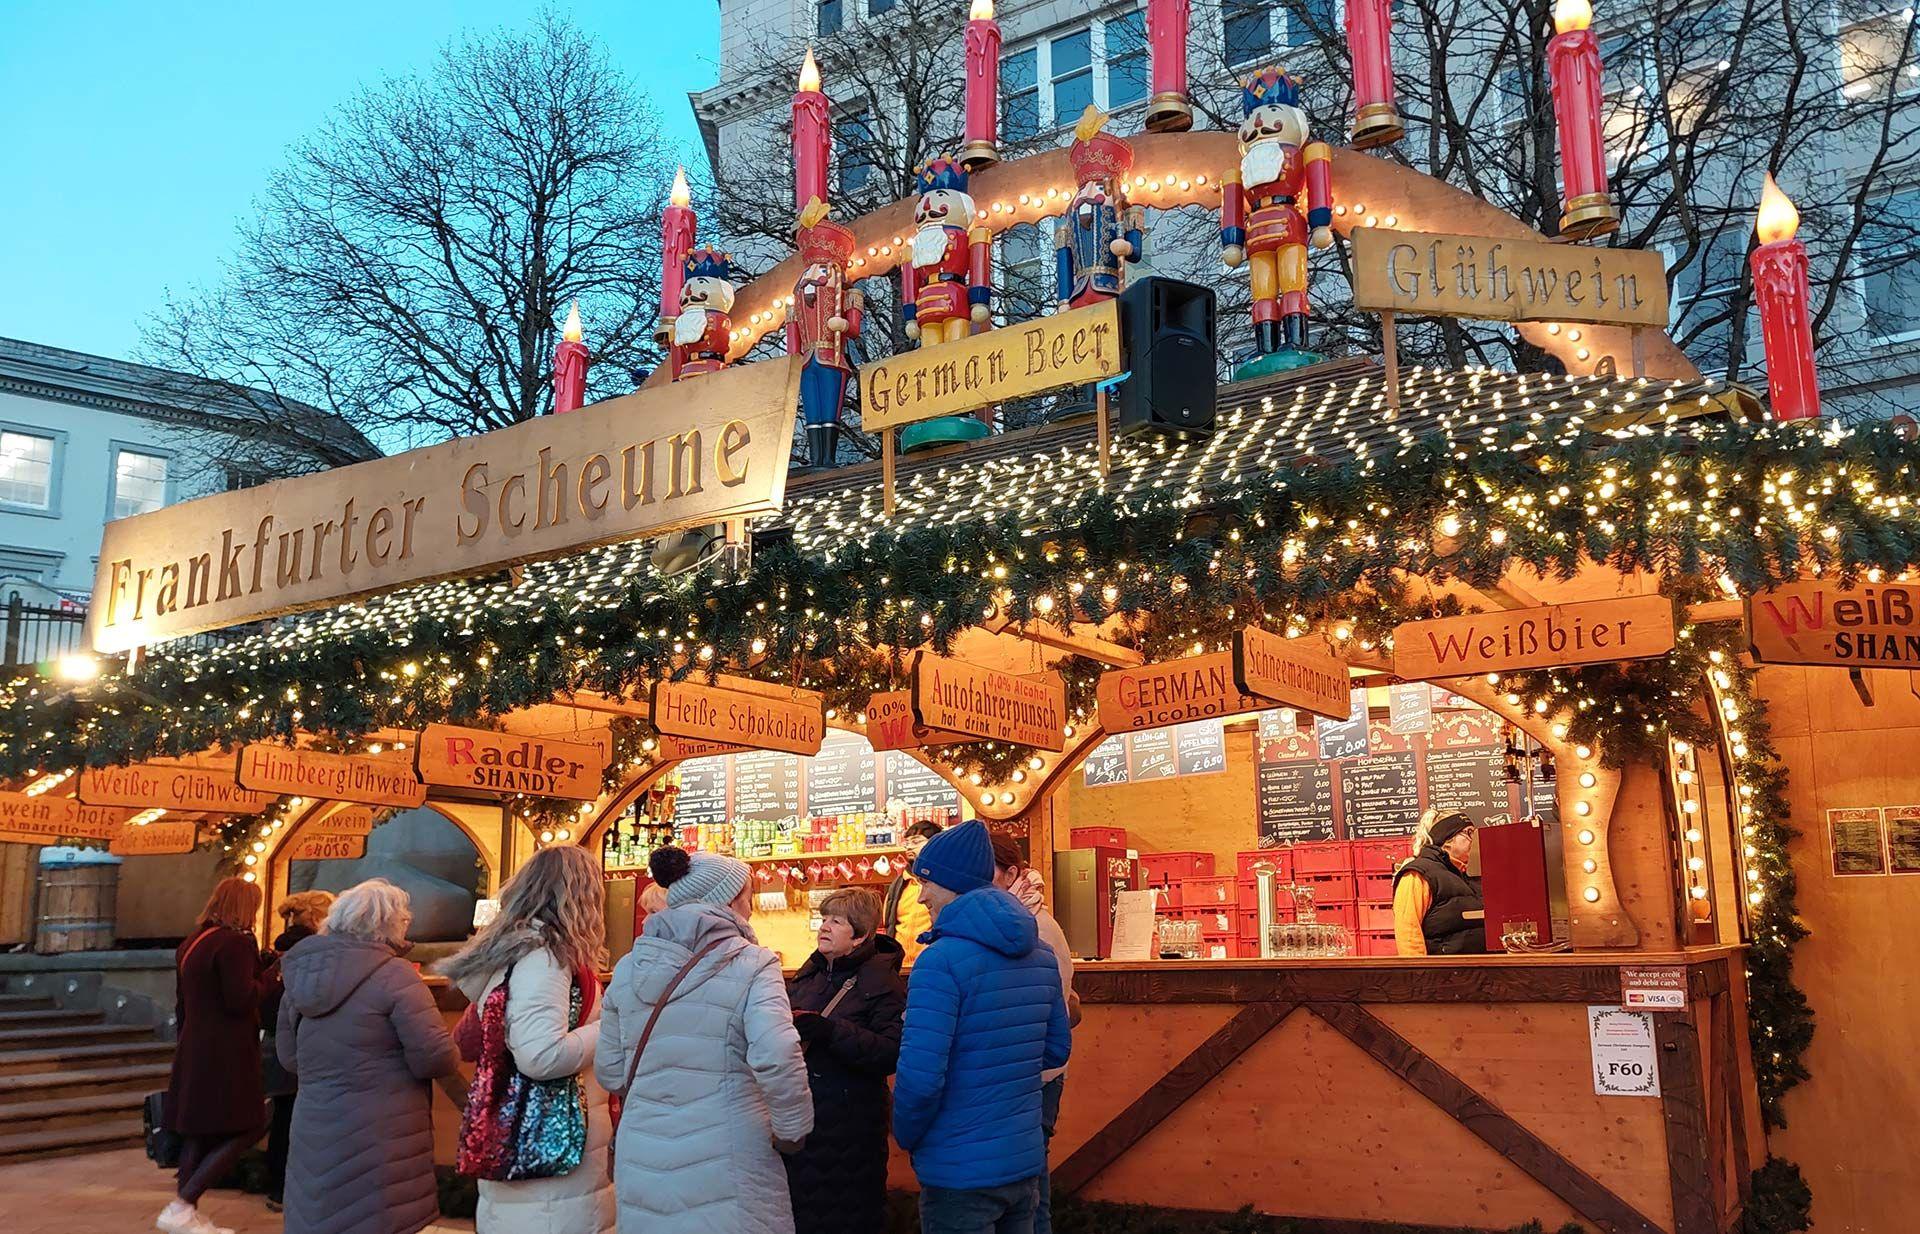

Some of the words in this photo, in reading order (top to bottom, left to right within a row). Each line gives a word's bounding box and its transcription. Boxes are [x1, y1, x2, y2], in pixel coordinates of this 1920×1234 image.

[1386, 241, 1644, 308] Glühwein
[868, 345, 1006, 416] German
[1023, 322, 1110, 375] Beer
[105, 494, 426, 626] Frankfurter
[456, 418, 751, 547] Scheune
[1762, 588, 1920, 635] Weiß
[1427, 616, 1632, 664] Weißbier
[1015, 680, 1048, 700] Alcohol
[1118, 665, 1228, 711] GERMAN
[1249, 637, 1349, 705] Schneemannpunsch
[667, 692, 717, 727] Heiße
[729, 704, 815, 743] Schokolade
[932, 669, 1057, 731] Autofahrerpunsch
[1132, 699, 1227, 727] alcohol
[941, 710, 957, 726] hot
[965, 717, 990, 733] drink
[998, 723, 1011, 738] for
[1018, 728, 1049, 745] drivers
[1179, 736, 1219, 748] APFELWEIN
[251, 751, 417, 797] Himbeerglühwein
[445, 737, 584, 780] Radler
[91, 769, 160, 797] Weißer
[65, 802, 115, 826] Shots
[1317, 804, 1331, 813] 9.00
[1639, 971, 1660, 979] accept
[1661, 970, 1681, 978] credit
[1648, 995, 1665, 1003] VISA
[1608, 1063, 1643, 1076] F60
